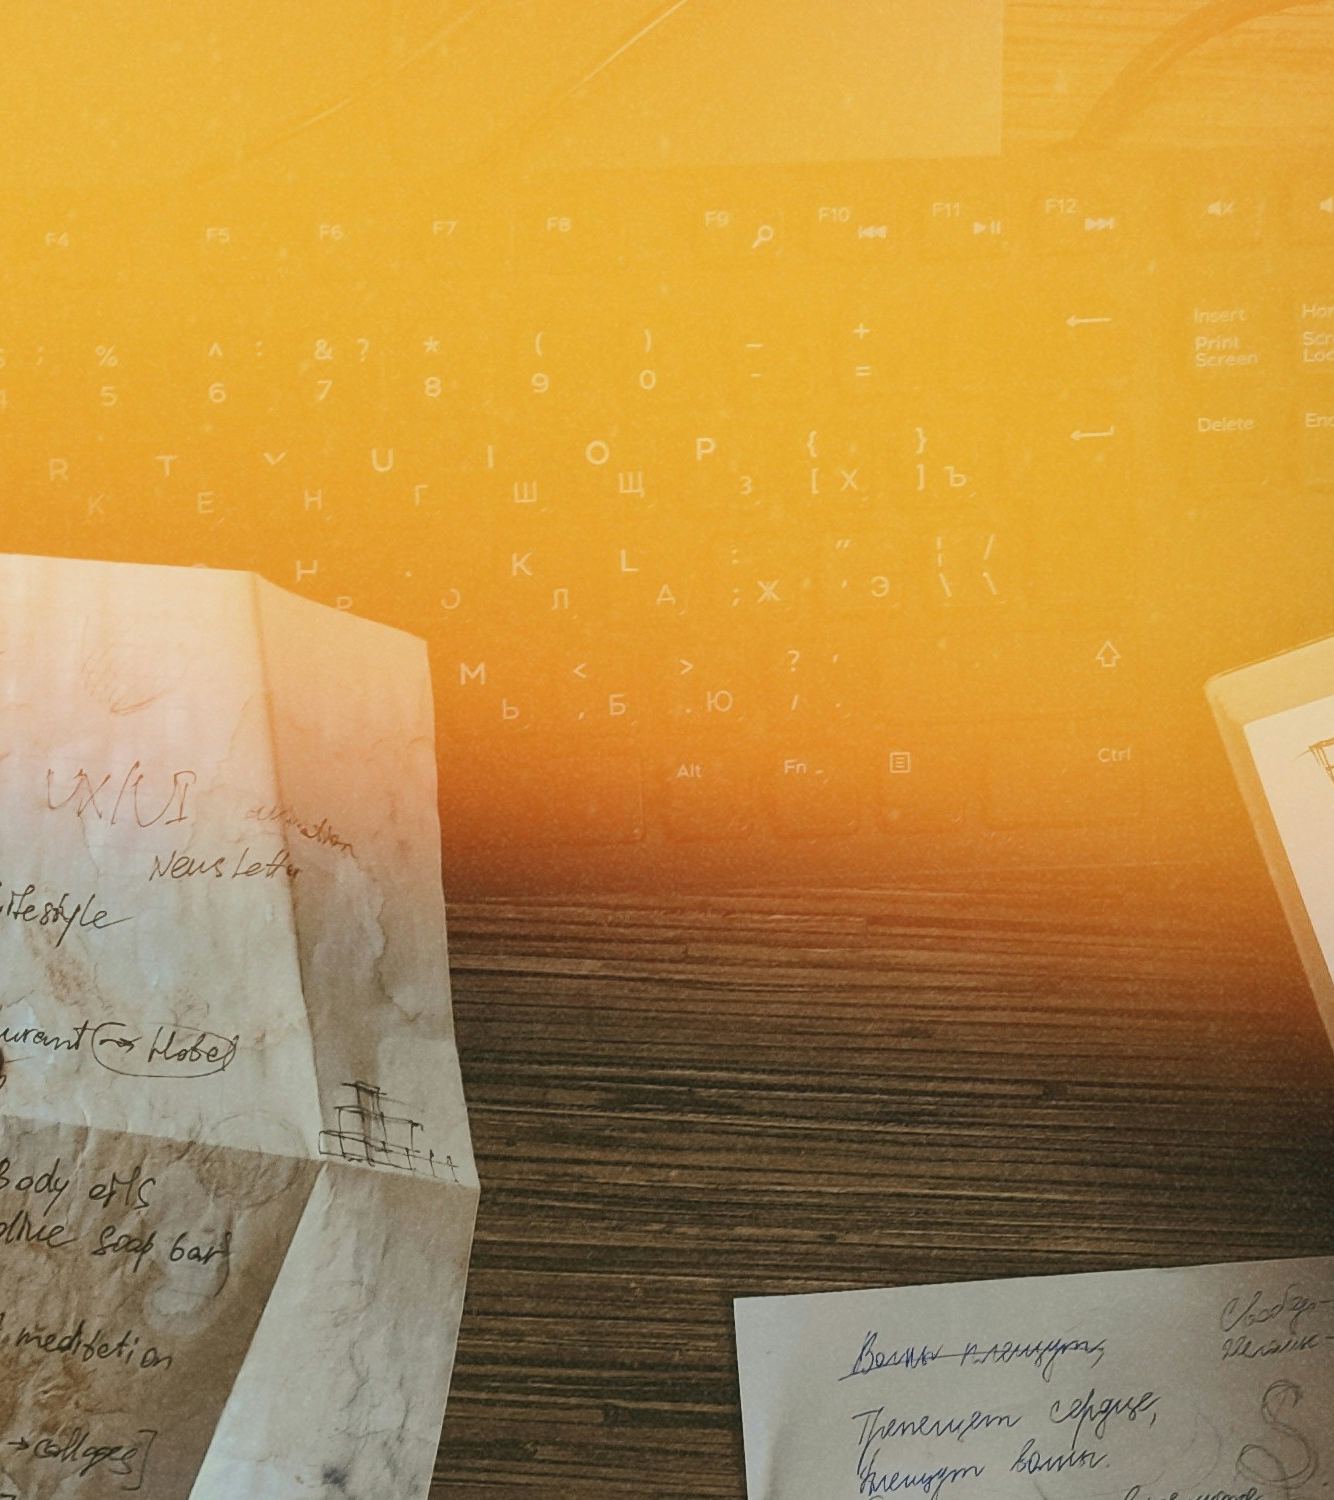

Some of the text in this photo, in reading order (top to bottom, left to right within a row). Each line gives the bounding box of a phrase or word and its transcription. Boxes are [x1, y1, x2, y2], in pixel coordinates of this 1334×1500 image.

[932, 202, 960, 217] F11
[1045, 198, 1077, 214] F12
[705, 211, 729, 228] F9
[818, 207, 850, 223] F10
[319, 224, 344, 241] F6
[433, 220, 457, 236] F7
[546, 217, 572, 232] F8
[44, 232, 69, 247] F4
[206, 227, 230, 243] F5
[1193, 308, 1246, 324] Insert
[1195, 335, 1241, 351] Print
[1195, 351, 1259, 368] Screen
[1197, 416, 1254, 433] Delete
[1097, 745, 1131, 763] Ctrl
[676, 763, 702, 780] Alt
[783, 758, 807, 776] Fn
